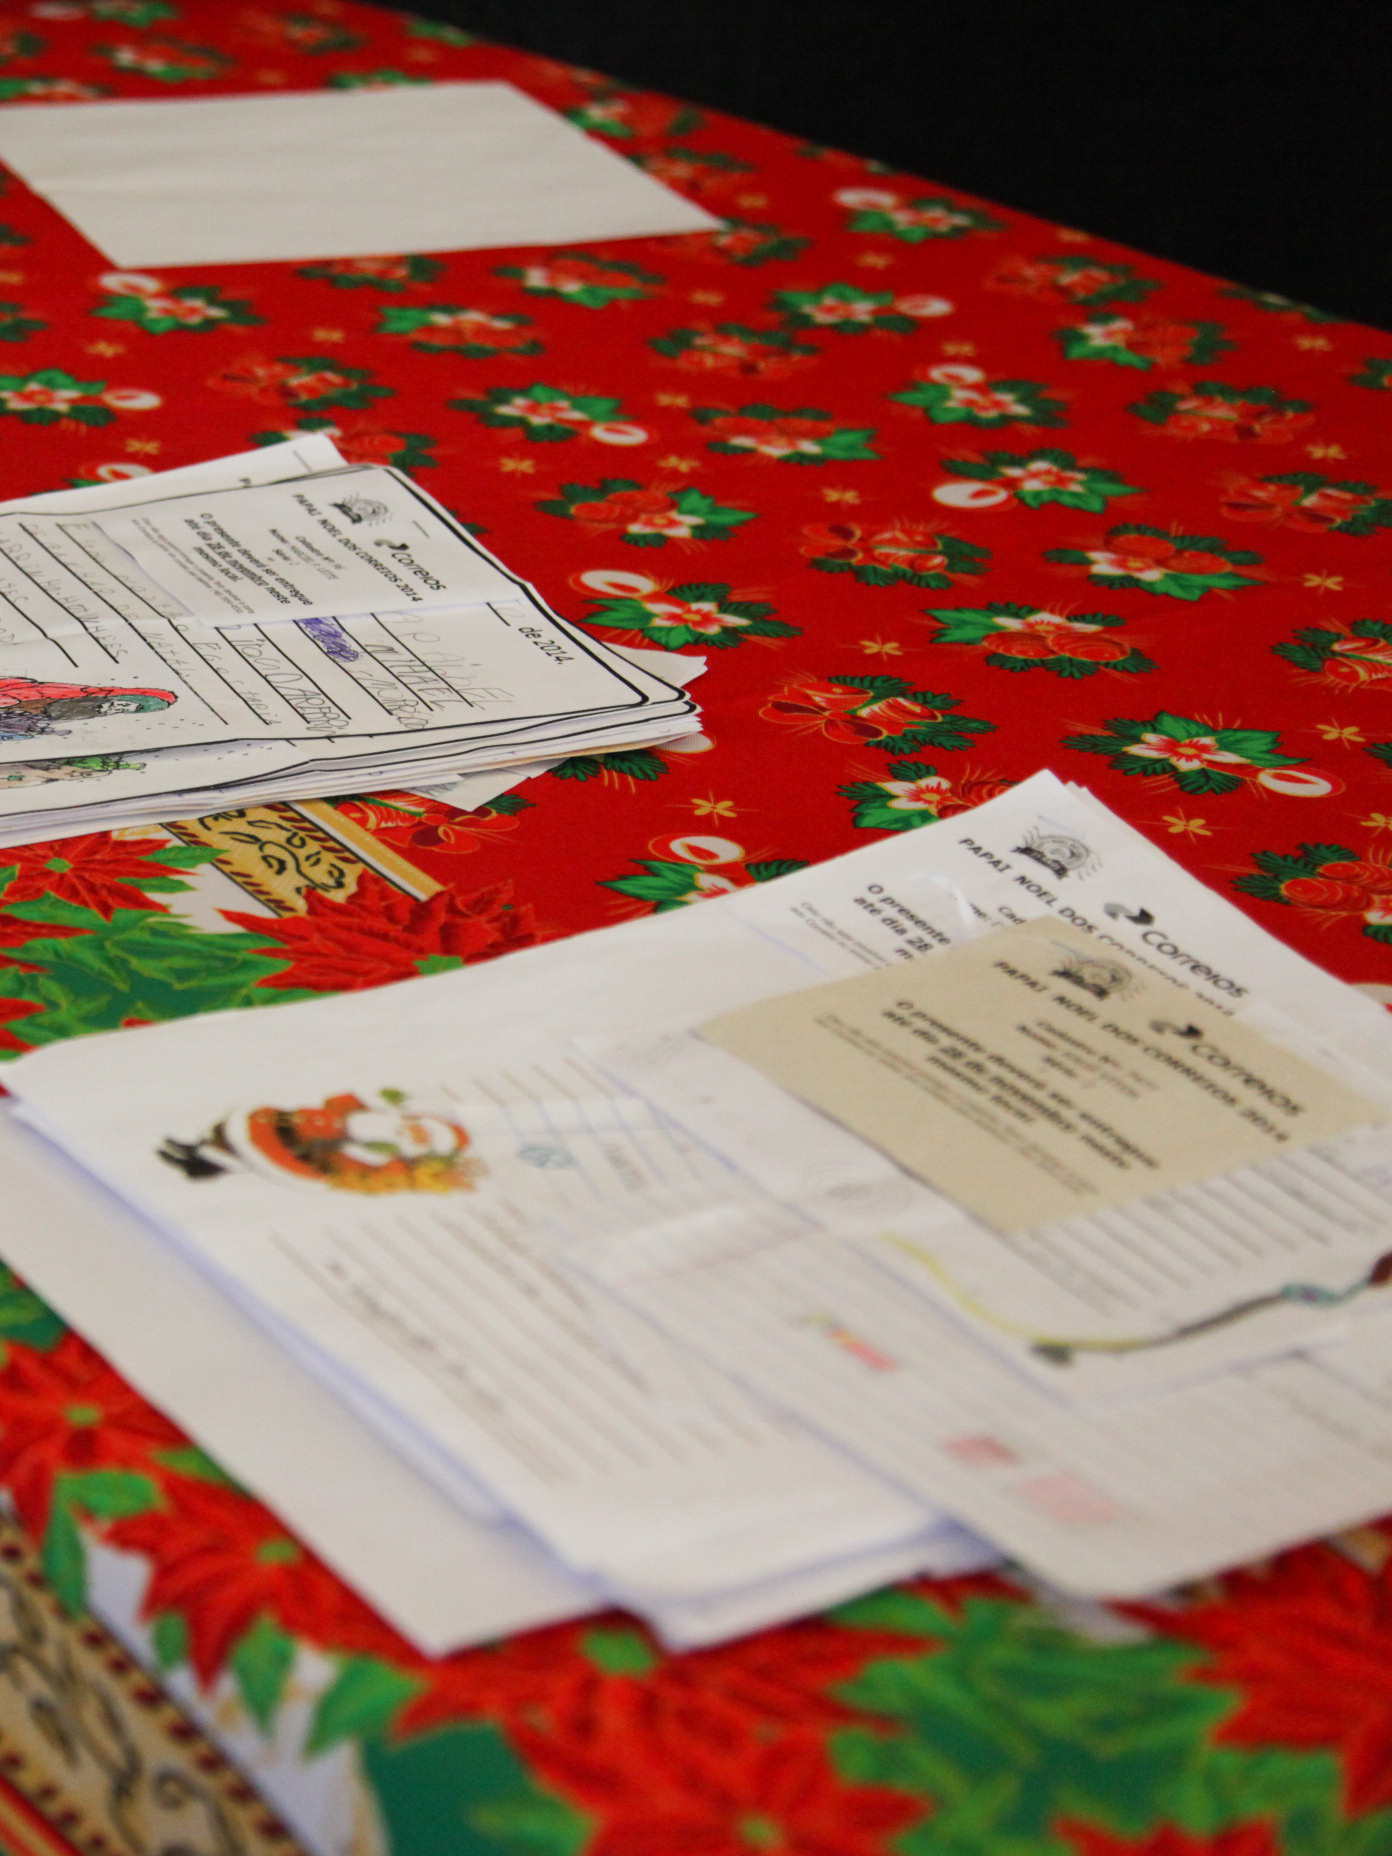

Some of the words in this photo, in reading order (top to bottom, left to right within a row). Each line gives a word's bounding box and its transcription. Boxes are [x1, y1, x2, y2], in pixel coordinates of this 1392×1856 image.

[184, 519, 202, 530] até
[196, 531, 212, 541] dia
[206, 542, 225, 551] 28
[293, 494, 322, 516] PAPAI
[318, 519, 341, 537] NOEL
[338, 538, 361, 551] DOS
[355, 551, 403, 583] CORREIOS
[395, 583, 423, 602] 2014
[193, 547, 223, 568] mesmo
[218, 568, 243, 582] local.
[204, 520, 242, 548] presente
[237, 548, 267, 568] deverá
[262, 568, 279, 576] ser
[275, 577, 313, 605] entregue
[214, 550, 233, 560] de
[225, 559, 269, 586] novembro
[391, 550, 447, 592] Correios
[265, 586, 291, 604] neste
[518, 627, 542, 638] de
[533, 640, 574, 665] 2014.
[959, 838, 1011, 873] PAPAI
[1014, 875, 1057, 906] NOEL
[1059, 908, 1098, 934] DOS
[854, 897, 883, 915] até
[881, 917, 908, 936] dia
[906, 937, 933, 952] 28
[867, 884, 884, 895] O
[879, 897, 951, 945] presente
[1141, 930, 1249, 998] Correios
[927, 1056, 989, 1094] mesmo
[994, 962, 1048, 993] PAPAI
[1054, 995, 1097, 1022] NOEL
[1102, 1024, 1140, 1045] DOS
[1143, 1045, 1241, 1107] CORREIOS
[1239, 1107, 1290, 1143] 2014
[883, 1011, 913, 1028] até
[913, 1028, 939, 1045] dia
[941, 1047, 967, 1061] 28
[965, 1061, 987, 1074] de
[988, 1076, 1077, 1131] novembro
[1081, 1134, 1131, 1170] neste
[896, 1001, 914, 1010] O
[909, 1011, 987, 1054] presente
[987, 1054, 1047, 1091] deverá
[1049, 1092, 1075, 1108] ser
[1078, 1112, 1160, 1169] entregue
[1190, 1043, 1300, 1116] Correios
